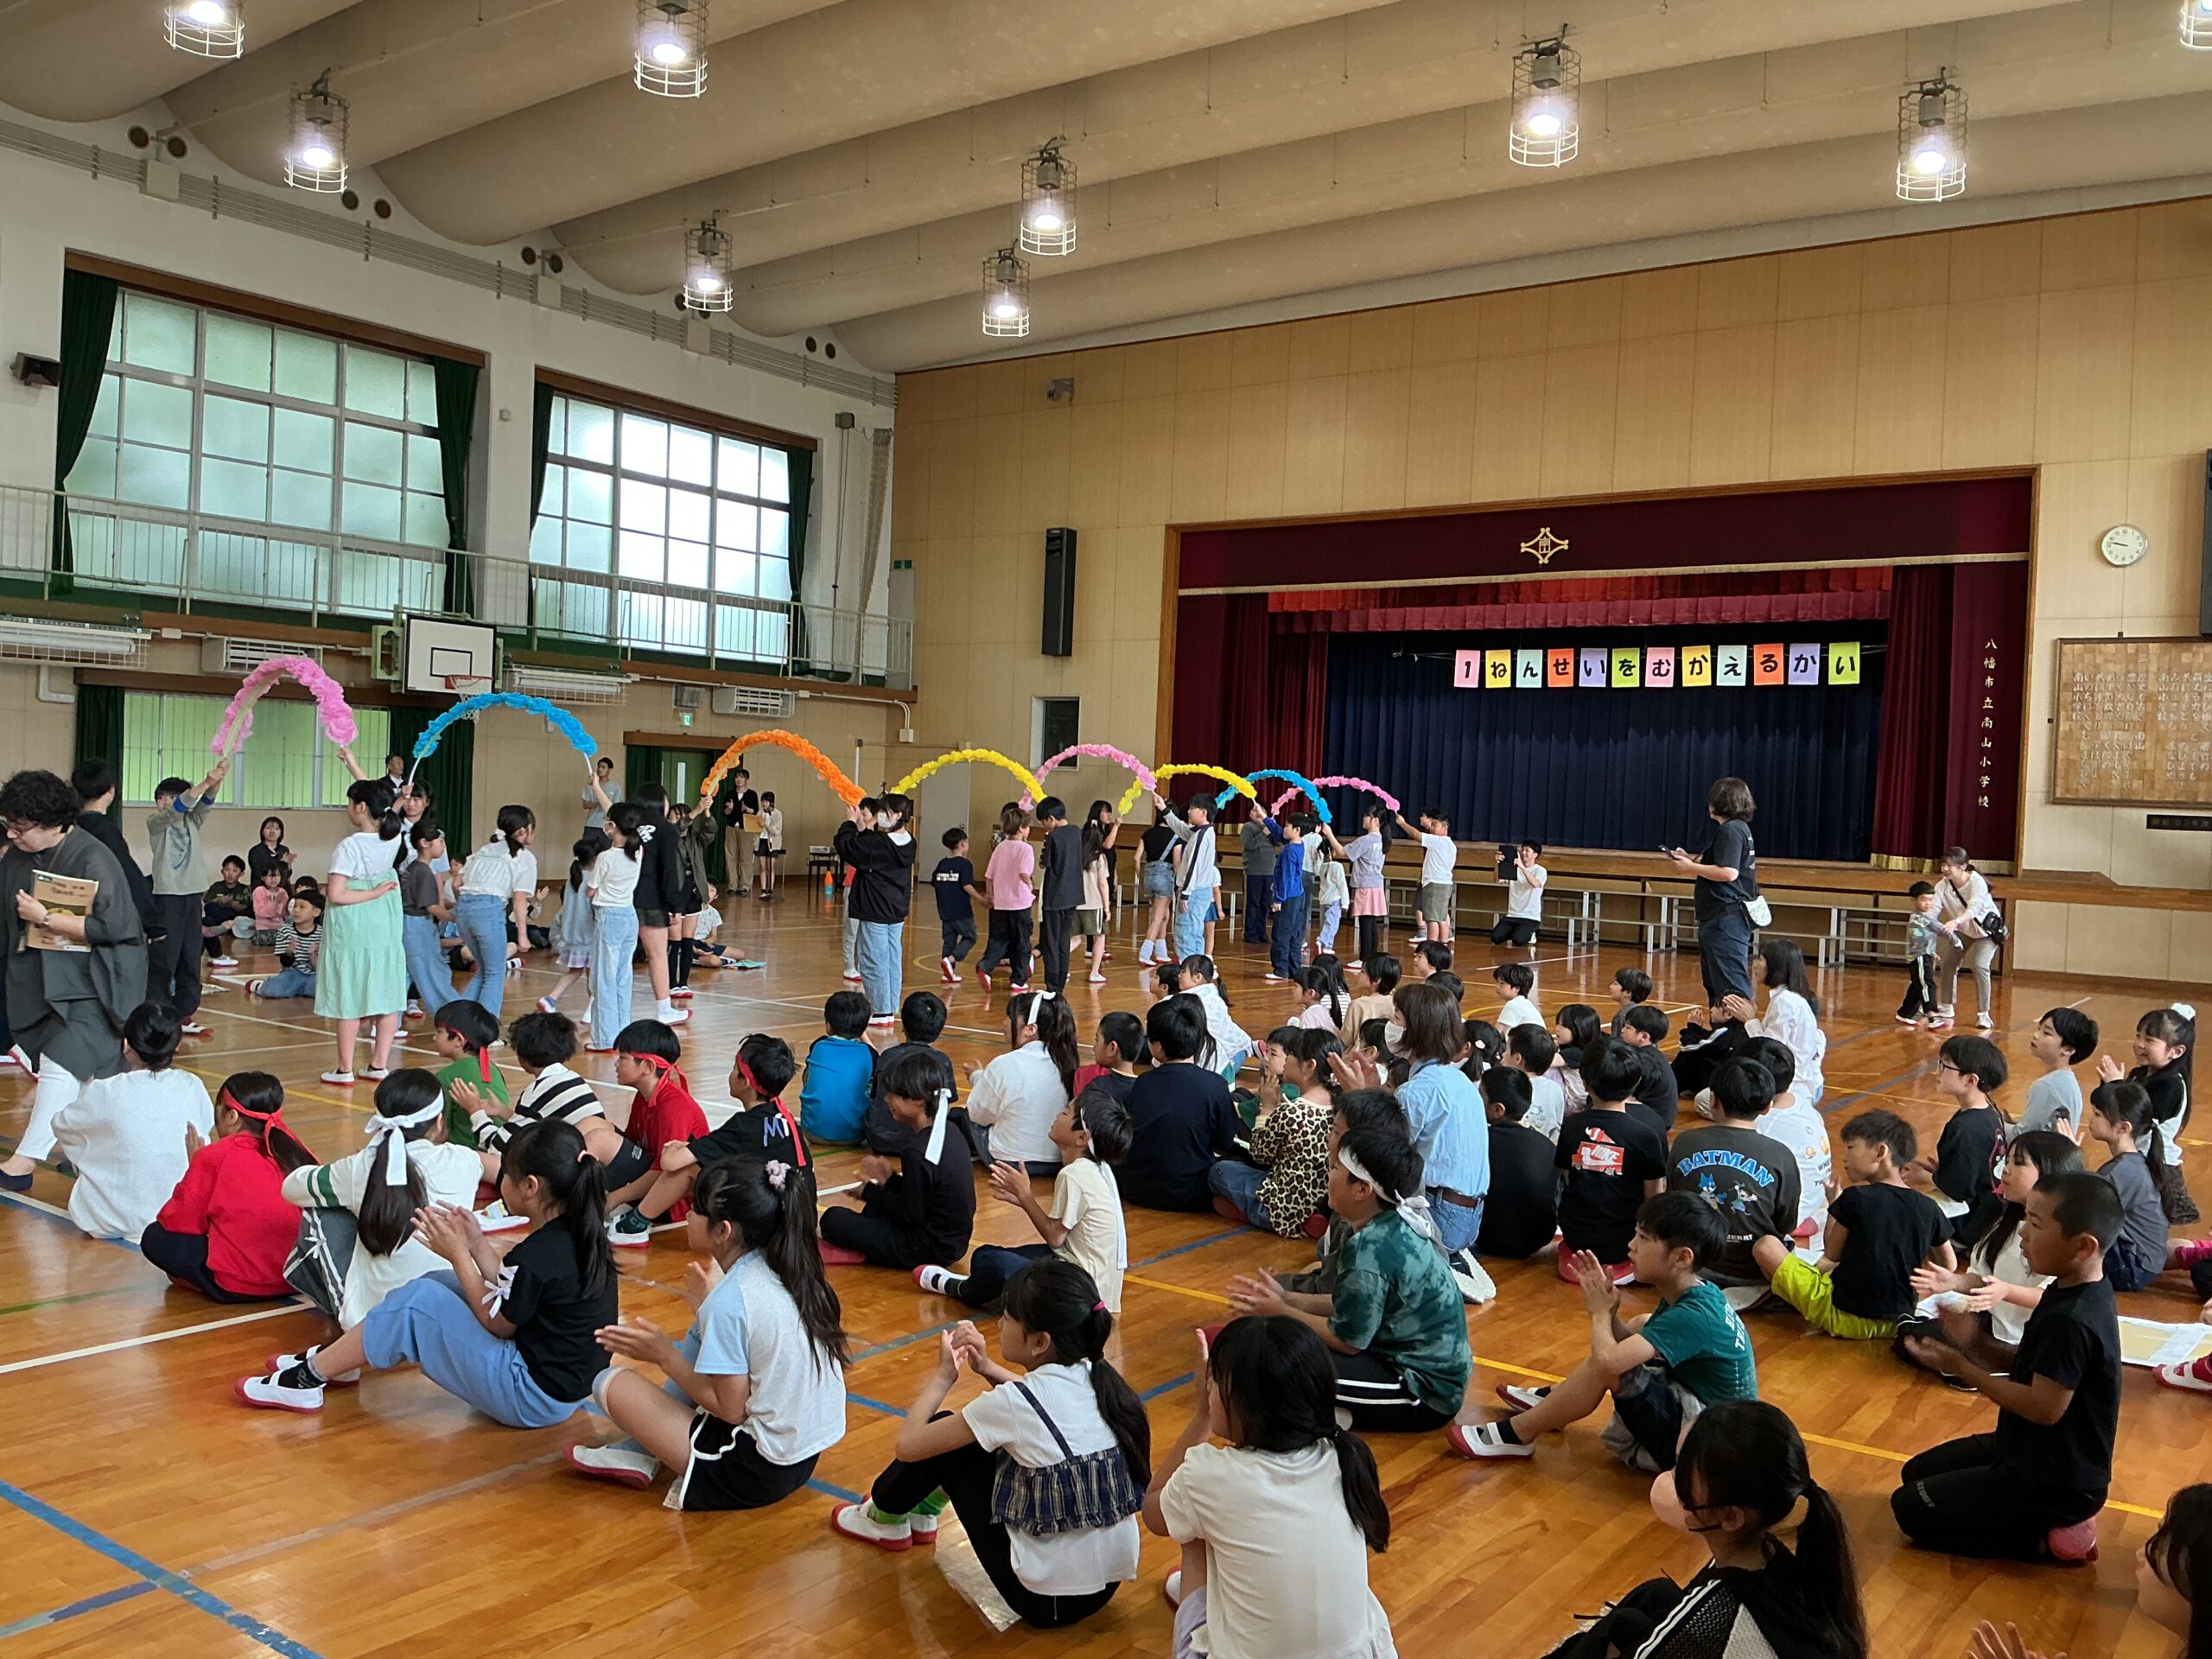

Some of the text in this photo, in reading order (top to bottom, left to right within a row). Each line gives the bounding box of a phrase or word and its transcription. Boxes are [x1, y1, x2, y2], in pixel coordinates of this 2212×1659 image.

[1464, 653, 1855, 678] 1ねんせいをむかえるかい
[2072, 672, 2084, 721] 南山小学校
[2158, 672, 2170, 722] 南山小学校
[1978, 639, 1998, 808] 八幡市立南山小学校
[2134, 731, 2145, 751] 南山
[1591, 1145, 1621, 1163] NIKE
[1676, 1149, 1775, 1188] BATMAN
